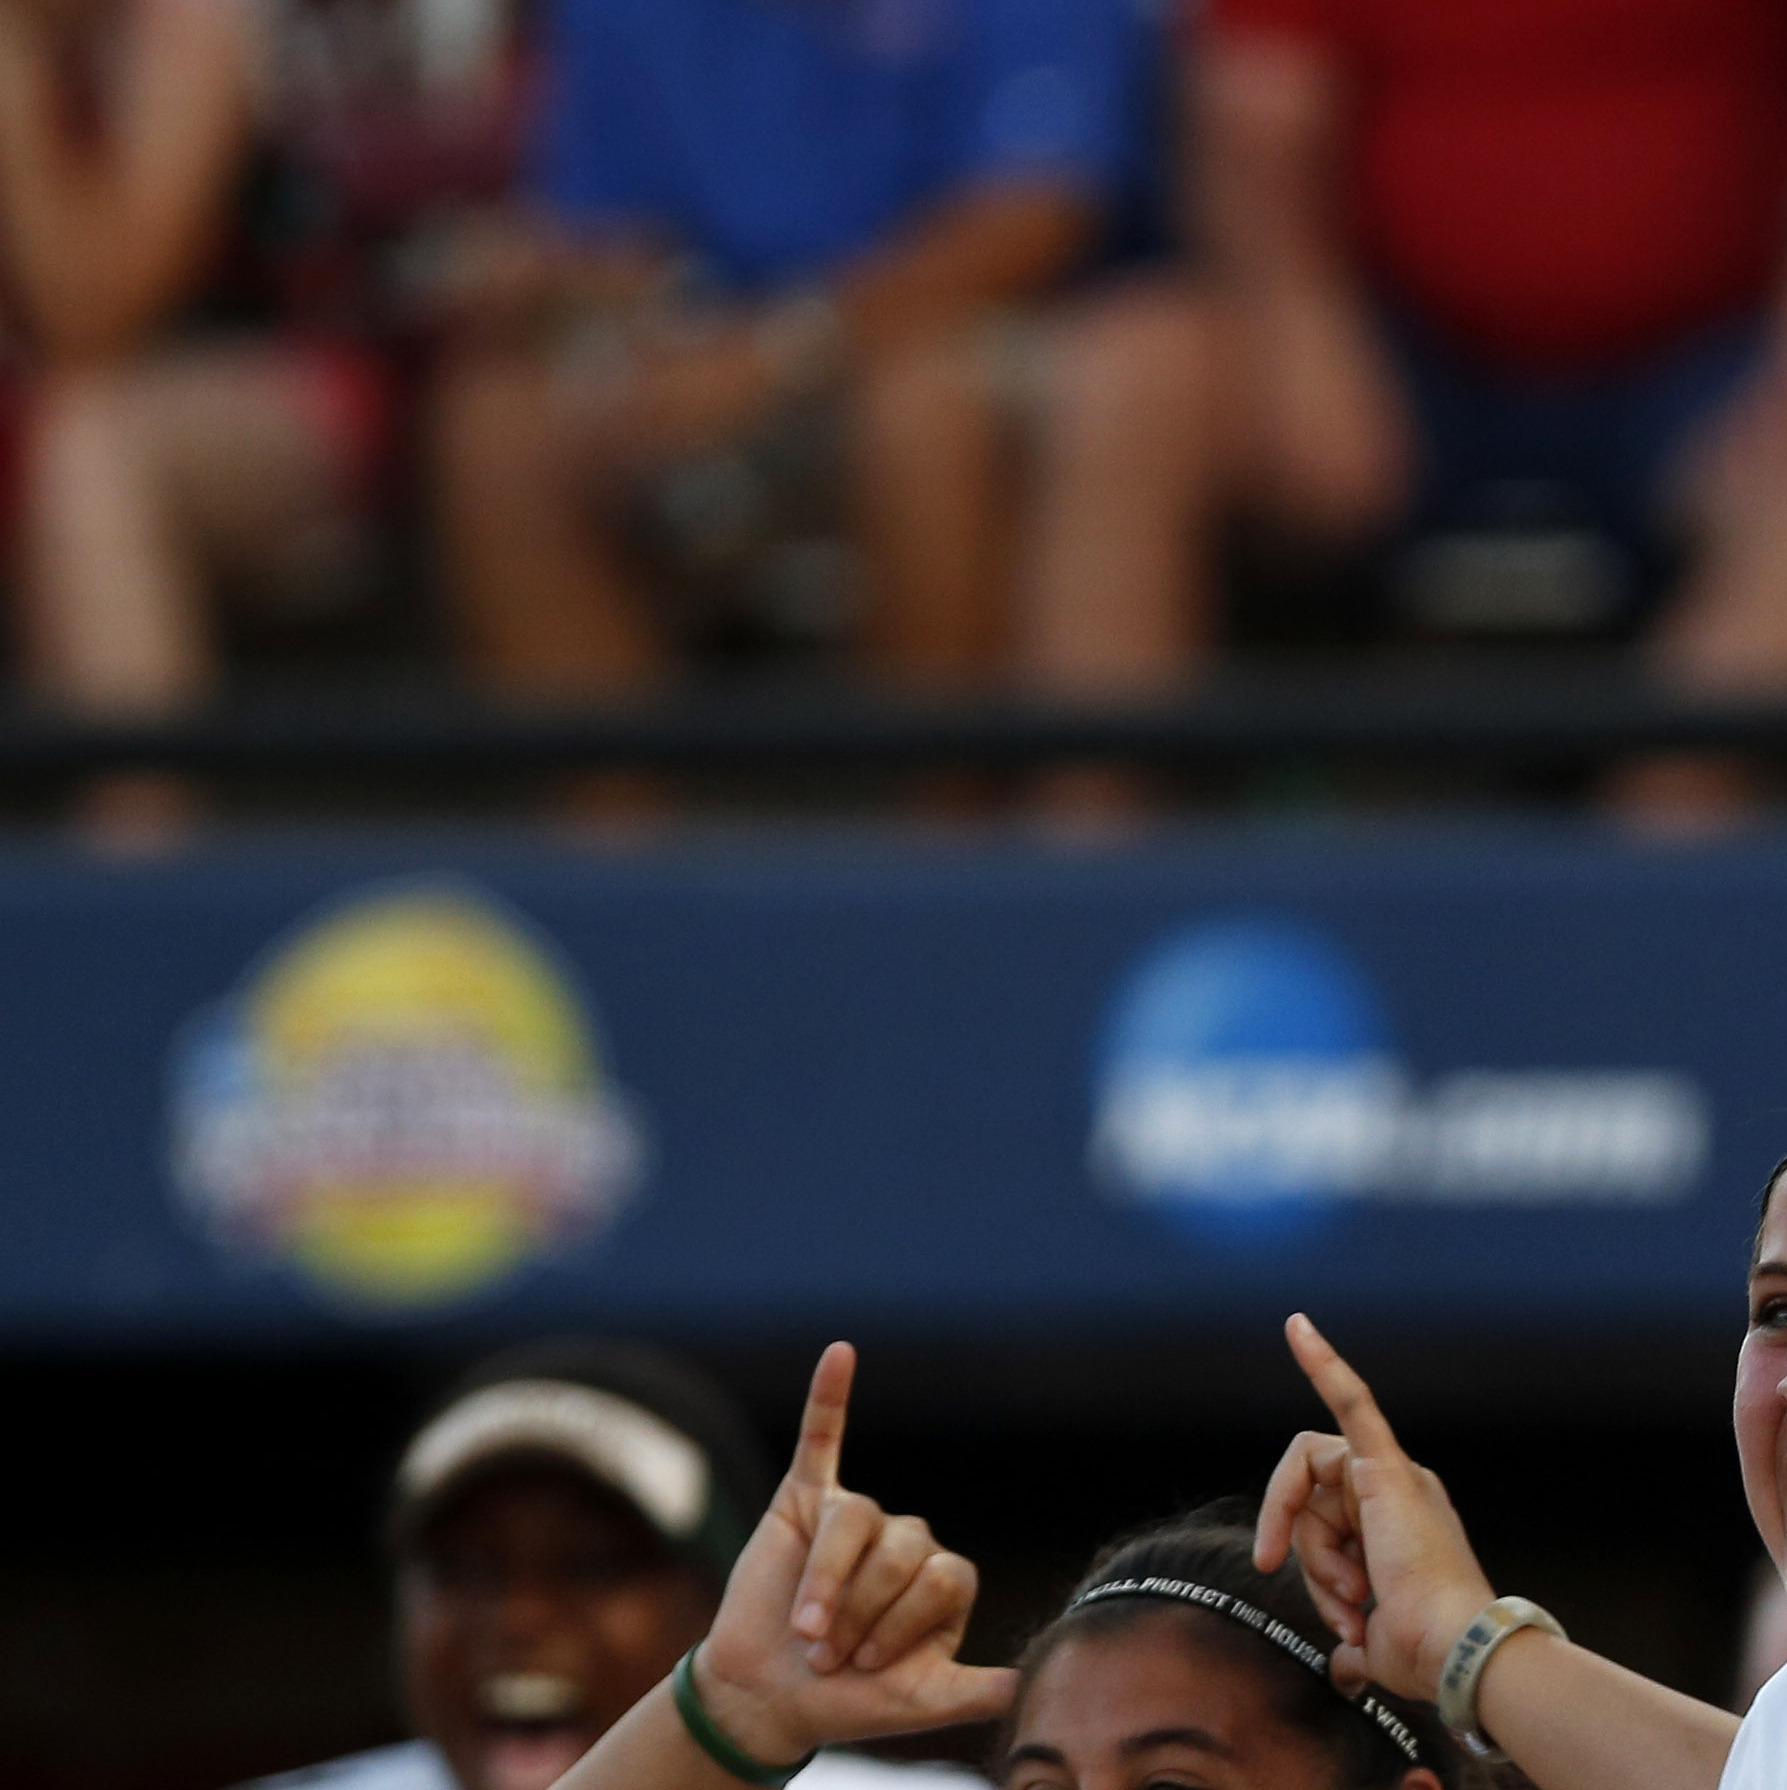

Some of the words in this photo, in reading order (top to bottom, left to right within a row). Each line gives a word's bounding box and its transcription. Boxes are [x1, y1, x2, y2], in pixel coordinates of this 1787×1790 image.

[1139, 1577, 1231, 1608] PROTECT
[1230, 1599, 1269, 1629] THIS
[1363, 1697, 1376, 1715] I
